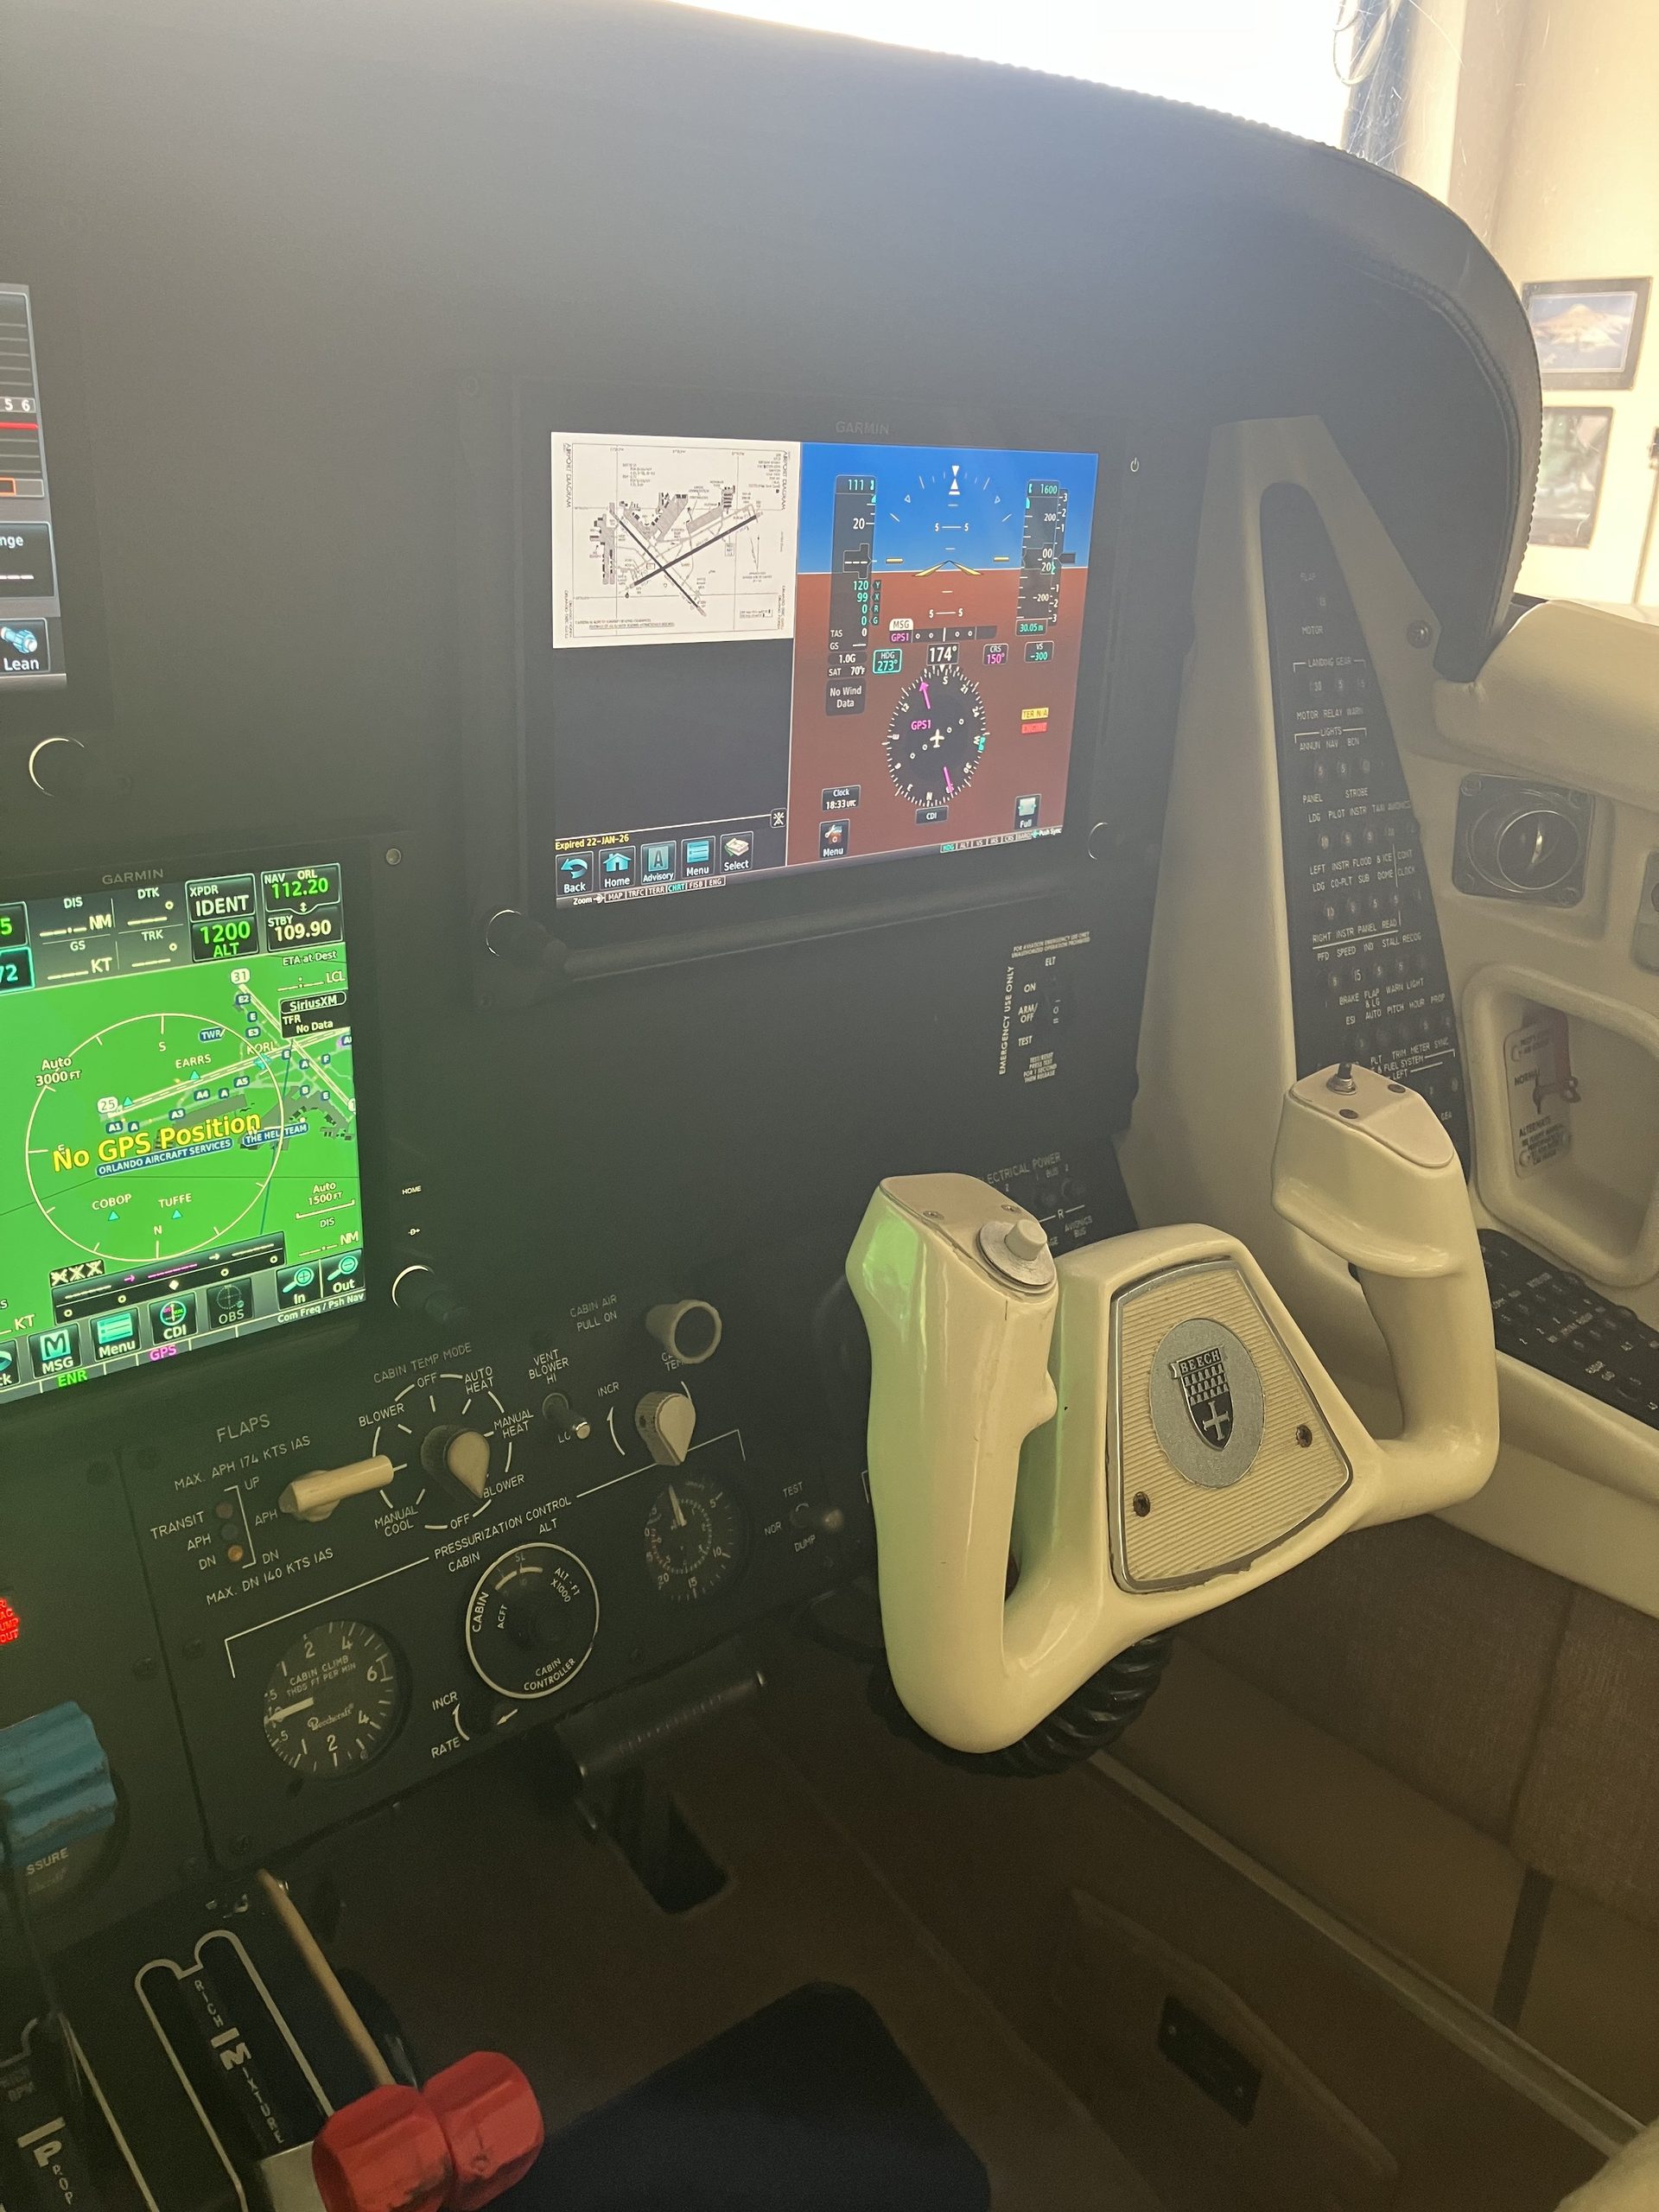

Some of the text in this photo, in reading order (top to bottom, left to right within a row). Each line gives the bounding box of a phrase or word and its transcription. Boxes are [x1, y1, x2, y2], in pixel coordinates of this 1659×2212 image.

[848, 479, 864, 491] 111
[1040, 484, 1058, 494] 1600
[854, 581, 868, 590] 120
[857, 593, 868, 602] 99
[891, 633, 909, 642] GPS1
[3, 657, 40, 671] Lean
[839, 654, 856, 663] 1.0G
[878, 659, 898, 671] 273°
[830, 686, 861, 696] No Wind
[836, 699, 854, 708] Data
[833, 788, 849, 797] Clock
[1303, 794, 1323, 804] PANEL
[826, 799, 846, 809] 18:33
[555, 834, 629, 850] Expired 22-JAN-26
[823, 847, 843, 856] Menu
[686, 867, 709, 876] Menu
[724, 860, 749, 871] Select
[101, 868, 164, 886] GARMIN
[264, 869, 318, 884] NAV ORL
[605, 876, 630, 887] Home
[643, 872, 674, 883] Advisory
[137, 887, 160, 899] DTK
[189, 885, 219, 897] XPDR
[270, 878, 329, 899] 112.20
[563, 882, 586, 893] Back
[63, 897, 83, 908] DIS
[194, 894, 250, 917] IDENT
[89, 914, 112, 930] NM
[267, 914, 293, 926] STBY
[142, 930, 163, 941] TRK
[200, 921, 251, 944] 1200
[275, 919, 332, 941] 109.90
[1313, 932, 1332, 943] RIGHT
[1358, 924, 1377, 934] PANEL
[70, 940, 86, 951] GS
[213, 942, 239, 957] ALT
[1317, 946, 1356, 961] PFD SPEED
[91, 958, 112, 973] KT
[282, 950, 337, 966] ETA at Dest
[1046, 957, 1056, 966] ELT
[1024, 982, 1036, 993] ON
[289, 994, 338, 1012] SiriusXM
[1339, 994, 1359, 1005] BRAKE
[296, 1019, 334, 1034] No Data
[999, 966, 1014, 1075] EMERGENCY USE ONLY
[1020, 1014, 1034, 1023] OFF
[1018, 1036, 1033, 1046] TEST
[41, 1057, 72, 1071] Auto
[175, 1054, 212, 1069] EARRS
[35, 1070, 68, 1087] 3000
[52, 1112, 262, 1173] No GPS Position
[99, 1138, 232, 1175] ORLANDO AIRCRAFT SERVICES
[313, 1182, 336, 1194] Auto
[92, 1193, 132, 1211] COBOP
[158, 1192, 193, 1208] TUFFE
[308, 1192, 333, 1205] 1500
[333, 1278, 355, 1294] Out
[569, 1294, 618, 1318] CABIN AIR
[219, 1310, 245, 1325] OBS
[576, 1311, 618, 1332] PULL ON
[163, 1325, 188, 1339] CDI
[99, 1339, 136, 1358] Menu
[149, 1344, 177, 1361] GPS
[373, 1342, 473, 1383] CABIN TEMP MODE
[533, 1349, 559, 1365] VENT
[1180, 1350, 1221, 1374] BEECH
[42, 1357, 73, 1375] MSG
[529, 1357, 569, 1380] BLOWER
[58, 1370, 87, 1388] ENR
[416, 1372, 437, 1388] OFF
[465, 1366, 493, 1383] AUTO
[466, 1376, 494, 1394] HEAT
[597, 1382, 620, 1396] INCR
[359, 1402, 405, 1427] BLOWER
[493, 1409, 534, 1430] MANUAL
[216, 1414, 270, 1443] FLAPS
[502, 1421, 530, 1439] HEAT
[175, 1435, 311, 1491] MAX. APH 174 KTS IAS
[244, 1477, 260, 1491] UP
[483, 1474, 525, 1499] BLOWER
[783, 1481, 803, 1497] TEST
[254, 1510, 278, 1527] APH
[374, 1505, 418, 1529] MANUAL
[450, 1513, 470, 1530] OFF
[149, 1511, 205, 1540] TRANSIT
[384, 1518, 414, 1537] COOL
[434, 1497, 572, 1560] PRESSURIZATION CONTROL
[538, 1517, 557, 1535] ALT
[764, 1522, 782, 1535] NOR
[187, 1534, 212, 1551] APH
[794, 1535, 816, 1553] DUMP
[198, 1555, 217, 1571] DN
[262, 1549, 279, 1565] DN
[448, 1552, 480, 1573] CABIN
[206, 1548, 334, 1605] MAX. DN 140 KTS IAS
[473, 1592, 489, 1632] CABIN
[498, 1605, 508, 1629] ACFT
[289, 1655, 349, 1686] CABIN CLIMB
[524, 1657, 576, 1691] CONTROLLER
[536, 1657, 562, 1676] CABIN
[432, 1691, 458, 1711] INCR
[430, 1737, 461, 1759] RATE
[194, 1979, 224, 2027] RICH
[219, 2042, 285, 2145] MIXTURE
